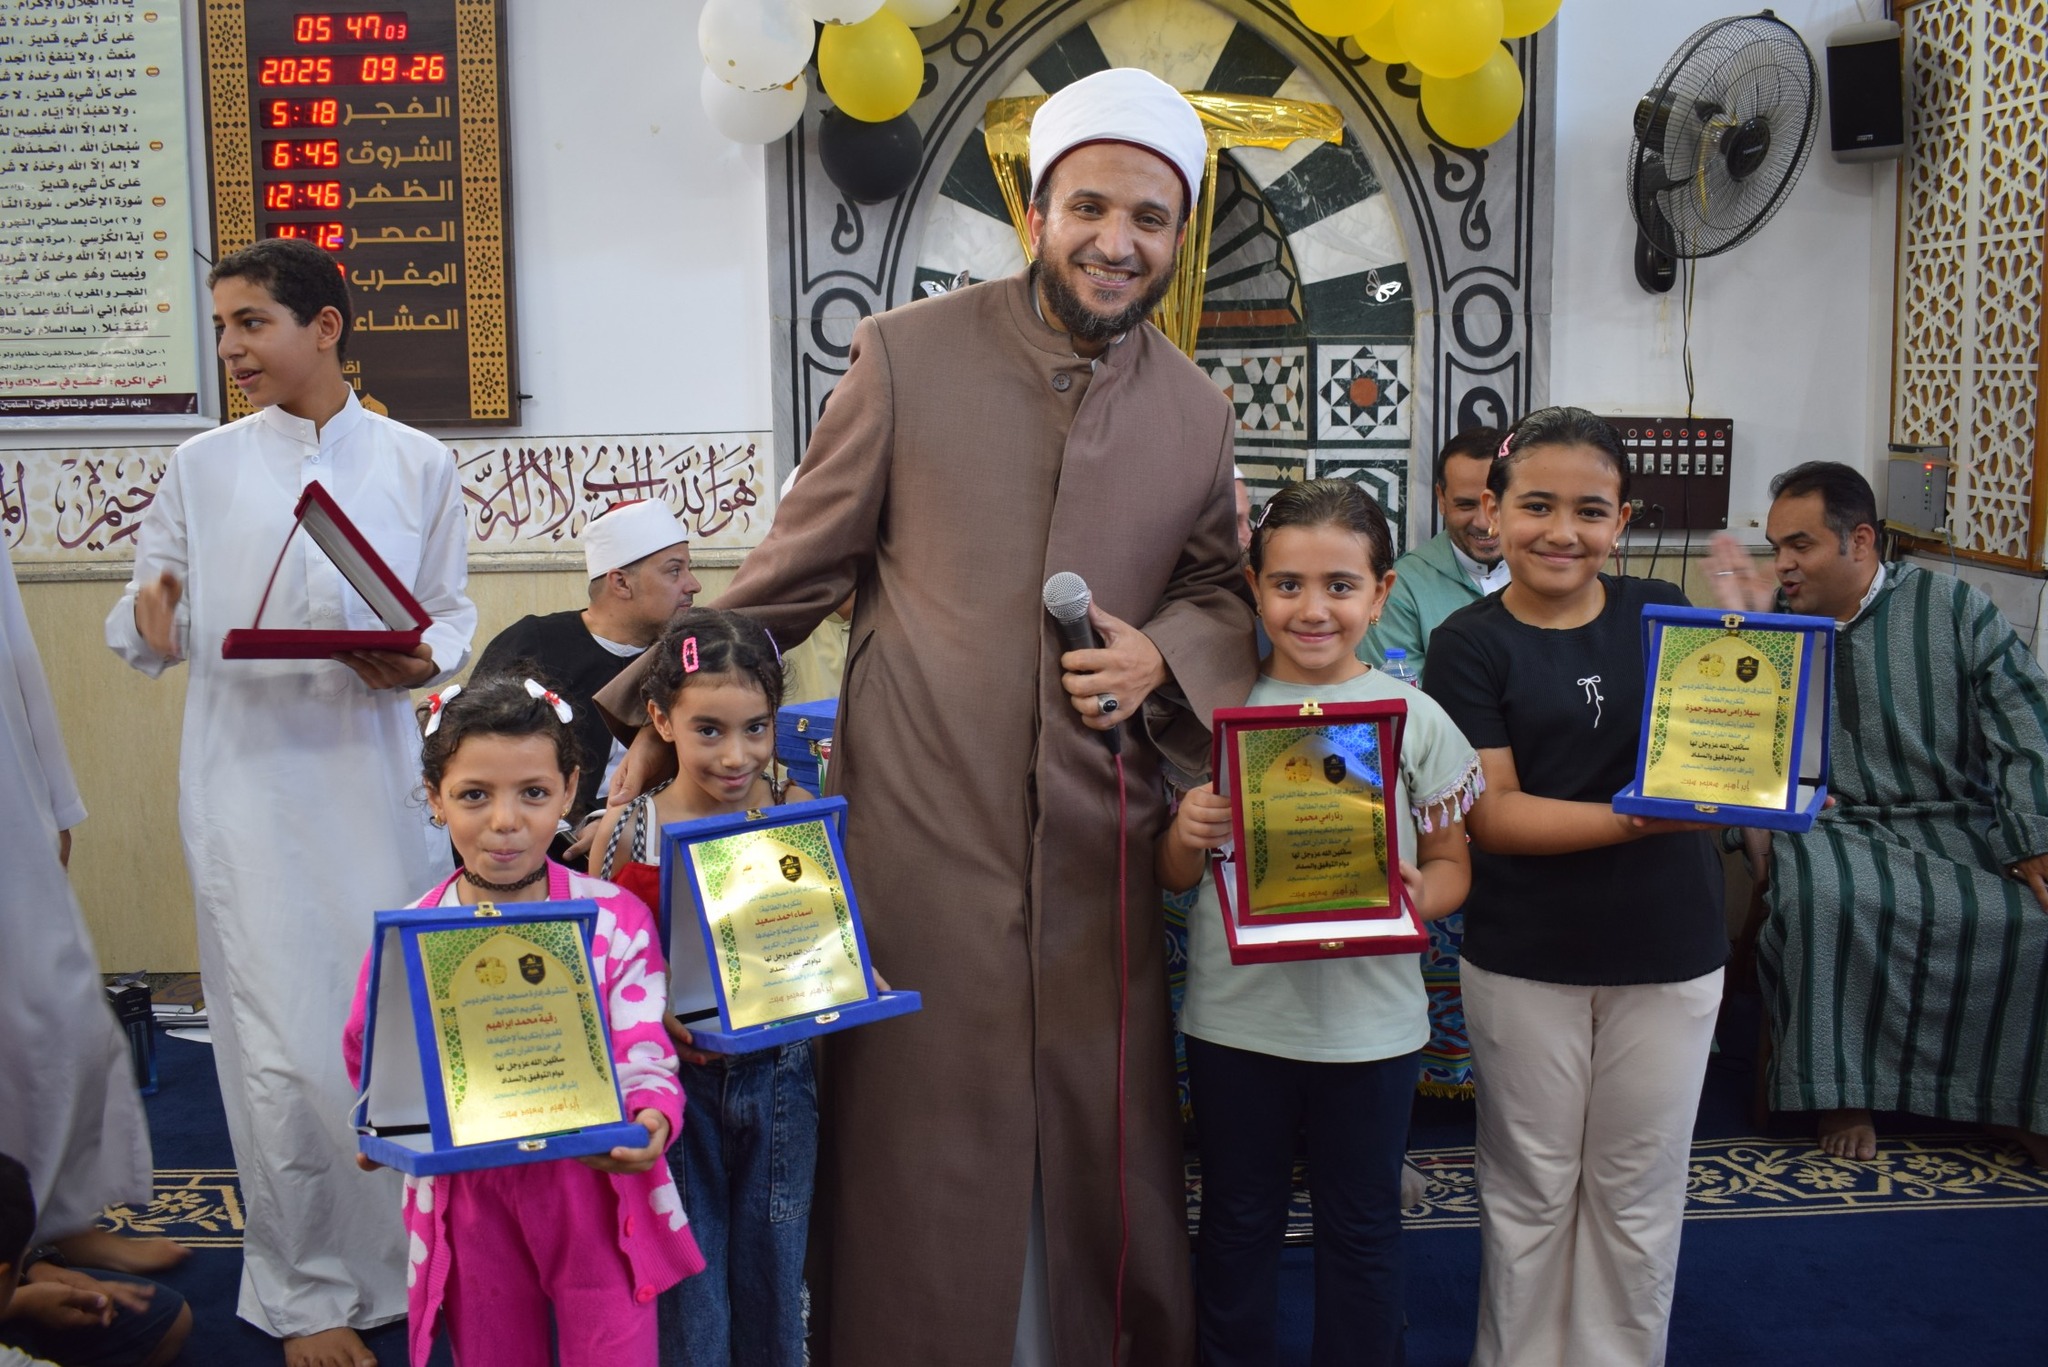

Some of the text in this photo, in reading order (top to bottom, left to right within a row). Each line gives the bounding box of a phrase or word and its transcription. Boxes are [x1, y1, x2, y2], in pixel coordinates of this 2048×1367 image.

[297, 16, 407, 42] 05 47 03
[261, 58, 332, 84] 2025
[272, 96, 450, 126] 5:18 الفجر
[274, 135, 452, 169] 6:45 الشروق
[267, 179, 453, 210] 12:46 الظهر
[348, 221, 455, 250] العصر
[351, 261, 457, 292] المغرب
[353, 304, 459, 331] العشاء
